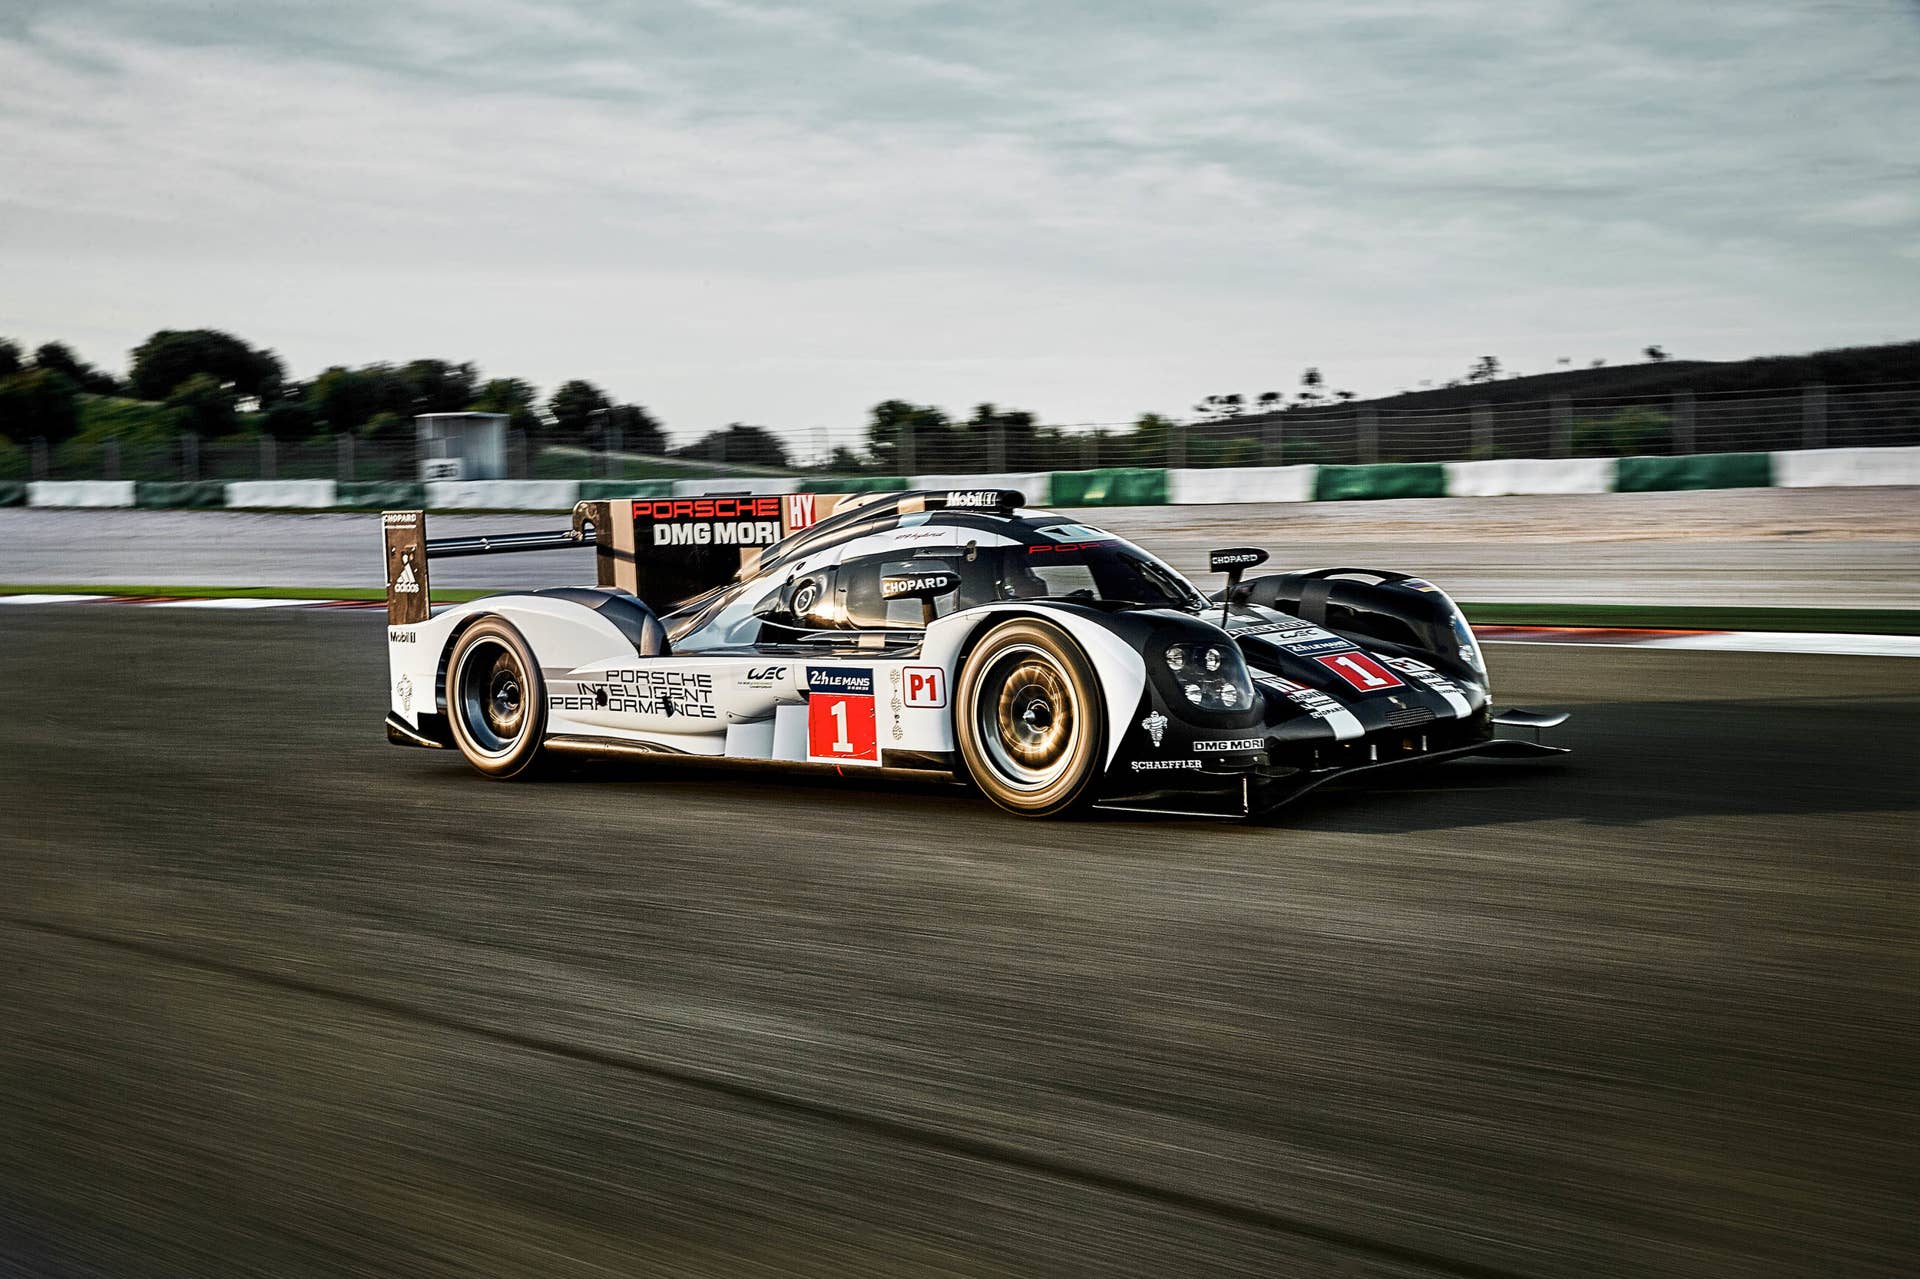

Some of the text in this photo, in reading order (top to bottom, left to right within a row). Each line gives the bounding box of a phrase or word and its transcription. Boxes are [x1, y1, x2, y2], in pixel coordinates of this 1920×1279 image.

[946, 491, 983, 507] Mobil
[632, 498, 780, 519] PORSCHE
[789, 494, 816, 530] HY
[384, 513, 417, 523] CHOPARD
[654, 521, 781, 546] DMG MORI
[1211, 554, 1258, 564] CHOPARD
[394, 582, 420, 593] adidas
[883, 577, 948, 594] CHOPARD
[390, 631, 409, 643] Mobil
[606, 670, 713, 688] PORSCHE
[747, 666, 787, 680] WEC
[810, 670, 870, 687] 24h LE MANS
[1335, 655, 1388, 687] 1
[577, 683, 713, 703] INTELLIGENT
[910, 674, 937, 701] P1
[1311, 706, 1346, 719] CHOPARD
[831, 701, 854, 753] 1
[1195, 740, 1264, 751] DMG MORI
[1131, 760, 1202, 770] SCHAEFFLER
